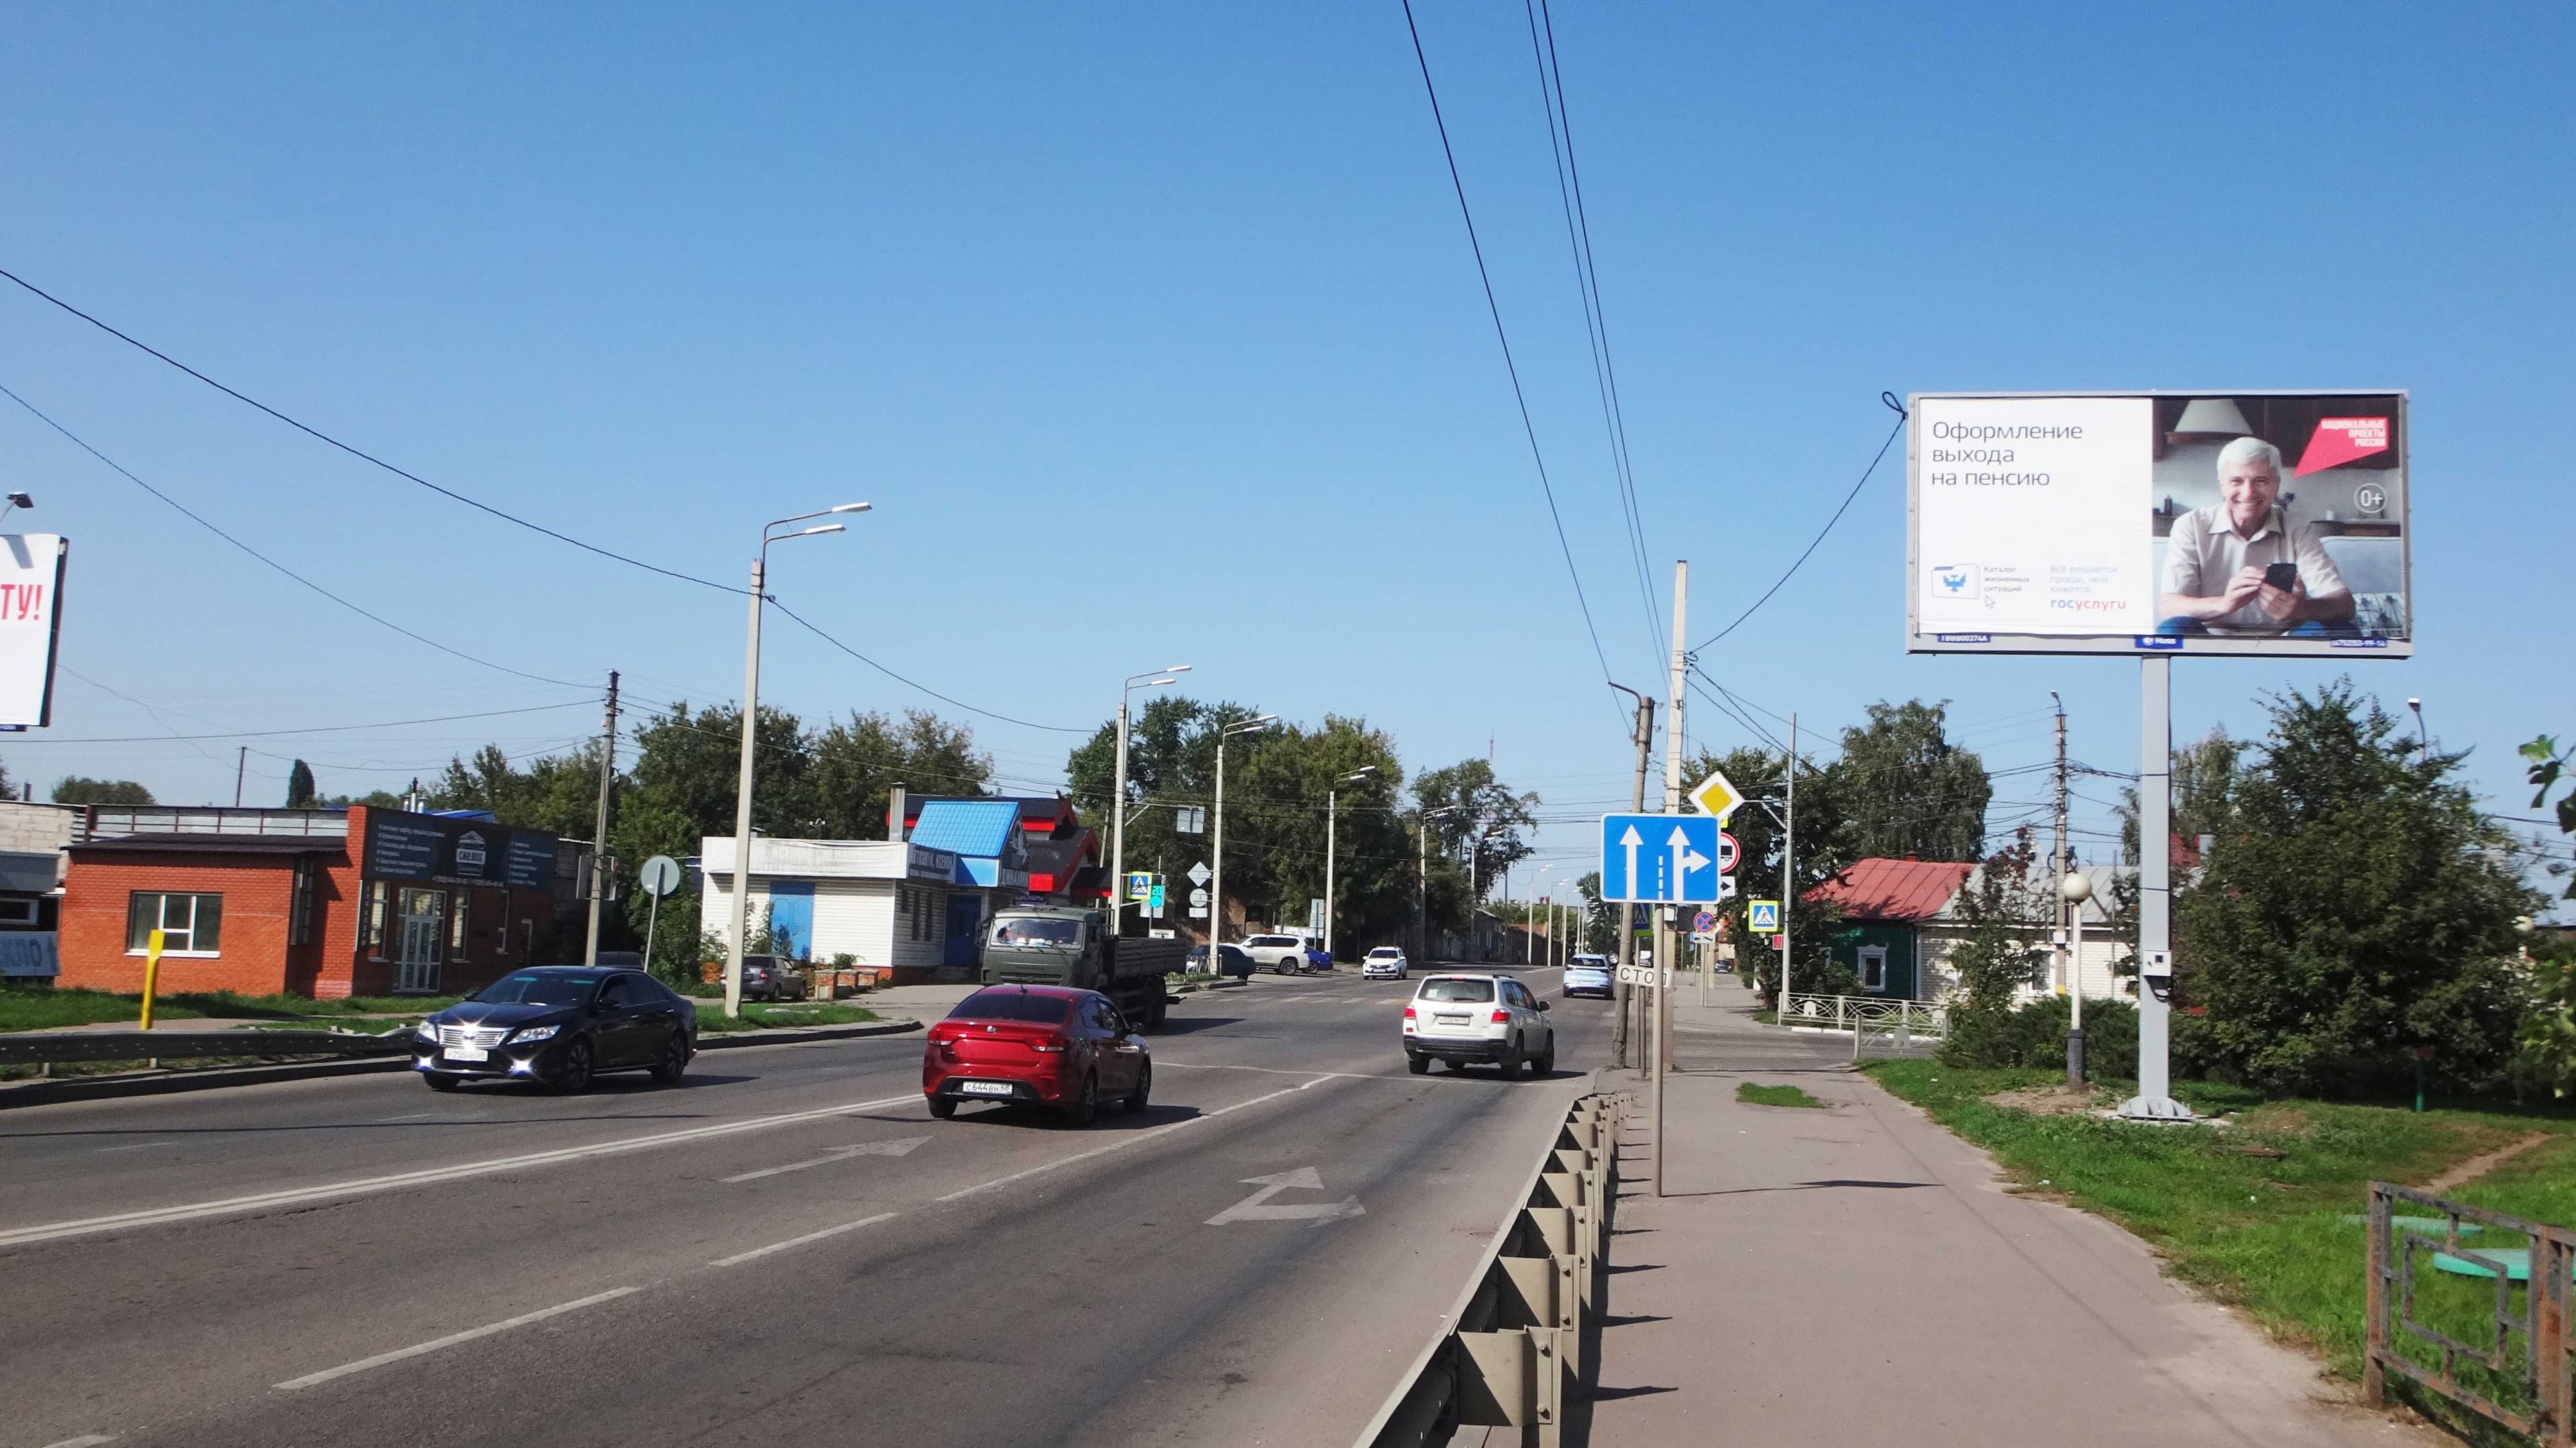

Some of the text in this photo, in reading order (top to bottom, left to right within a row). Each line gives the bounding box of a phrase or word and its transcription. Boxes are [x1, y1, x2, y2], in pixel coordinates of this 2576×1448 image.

[1933, 421, 2083, 443] Оформление
[1933, 450, 2015, 466] выхода
[1932, 472, 2050, 486] на пенсию
[2360, 490, 2383, 507] 0+
